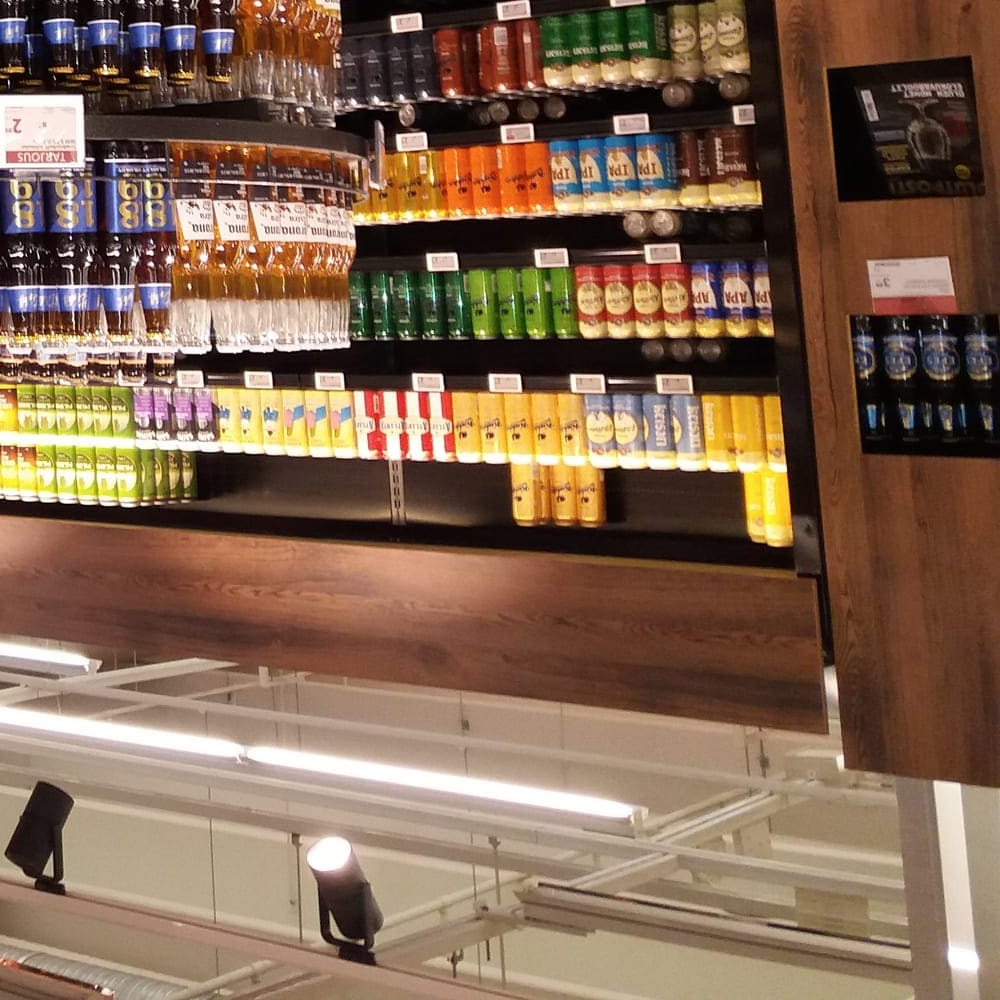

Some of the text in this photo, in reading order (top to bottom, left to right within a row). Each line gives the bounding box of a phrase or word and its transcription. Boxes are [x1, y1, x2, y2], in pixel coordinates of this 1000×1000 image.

[16, 152, 65, 163] TARJOUS
[551, 167, 569, 180] IPA
[582, 166, 593, 178] IP
[609, 163, 629, 176] IPA
[638, 162, 657, 175] IPA
[55, 173, 93, 199] 19
[56, 200, 94, 228] 18
[694, 292, 709, 303] AP
[725, 291, 747, 303] APA
